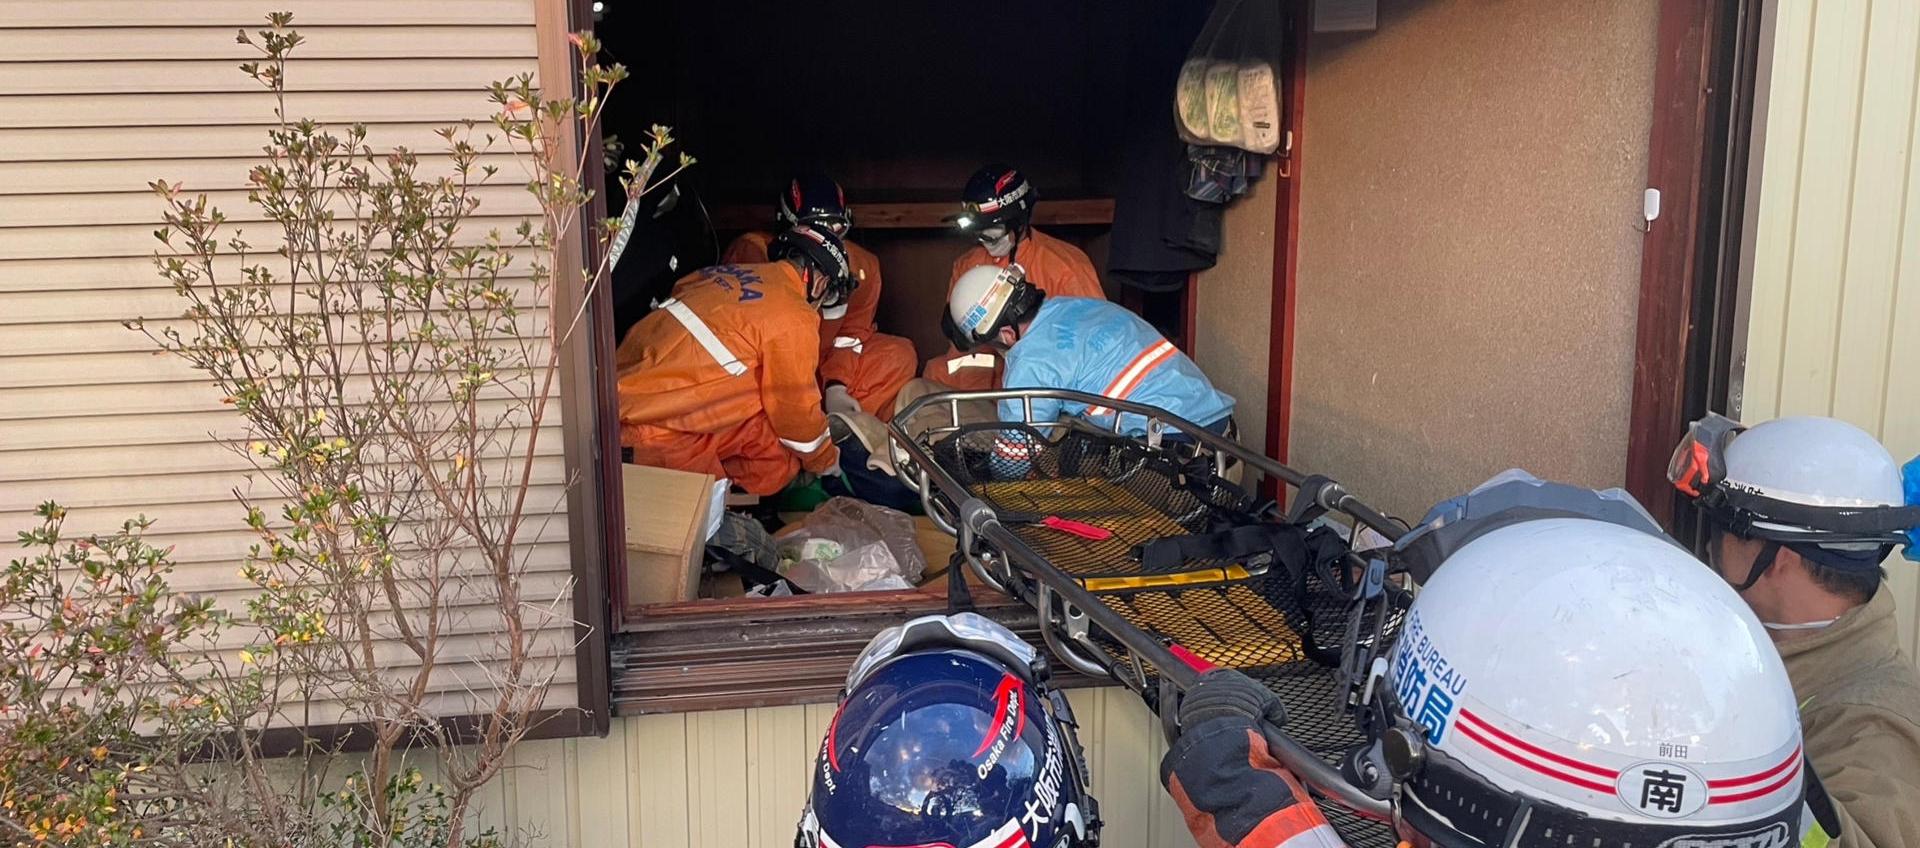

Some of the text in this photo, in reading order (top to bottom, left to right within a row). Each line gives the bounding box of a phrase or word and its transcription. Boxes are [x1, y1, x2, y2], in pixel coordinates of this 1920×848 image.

[1417, 635, 1467, 696] BUREAU
[977, 738, 1006, 780] Osaka
[1000, 715, 1016, 741] Fire
[1658, 743, 1689, 760] 前田
[823, 762, 837, 796] Dept.
[1639, 768, 1688, 814] 南
